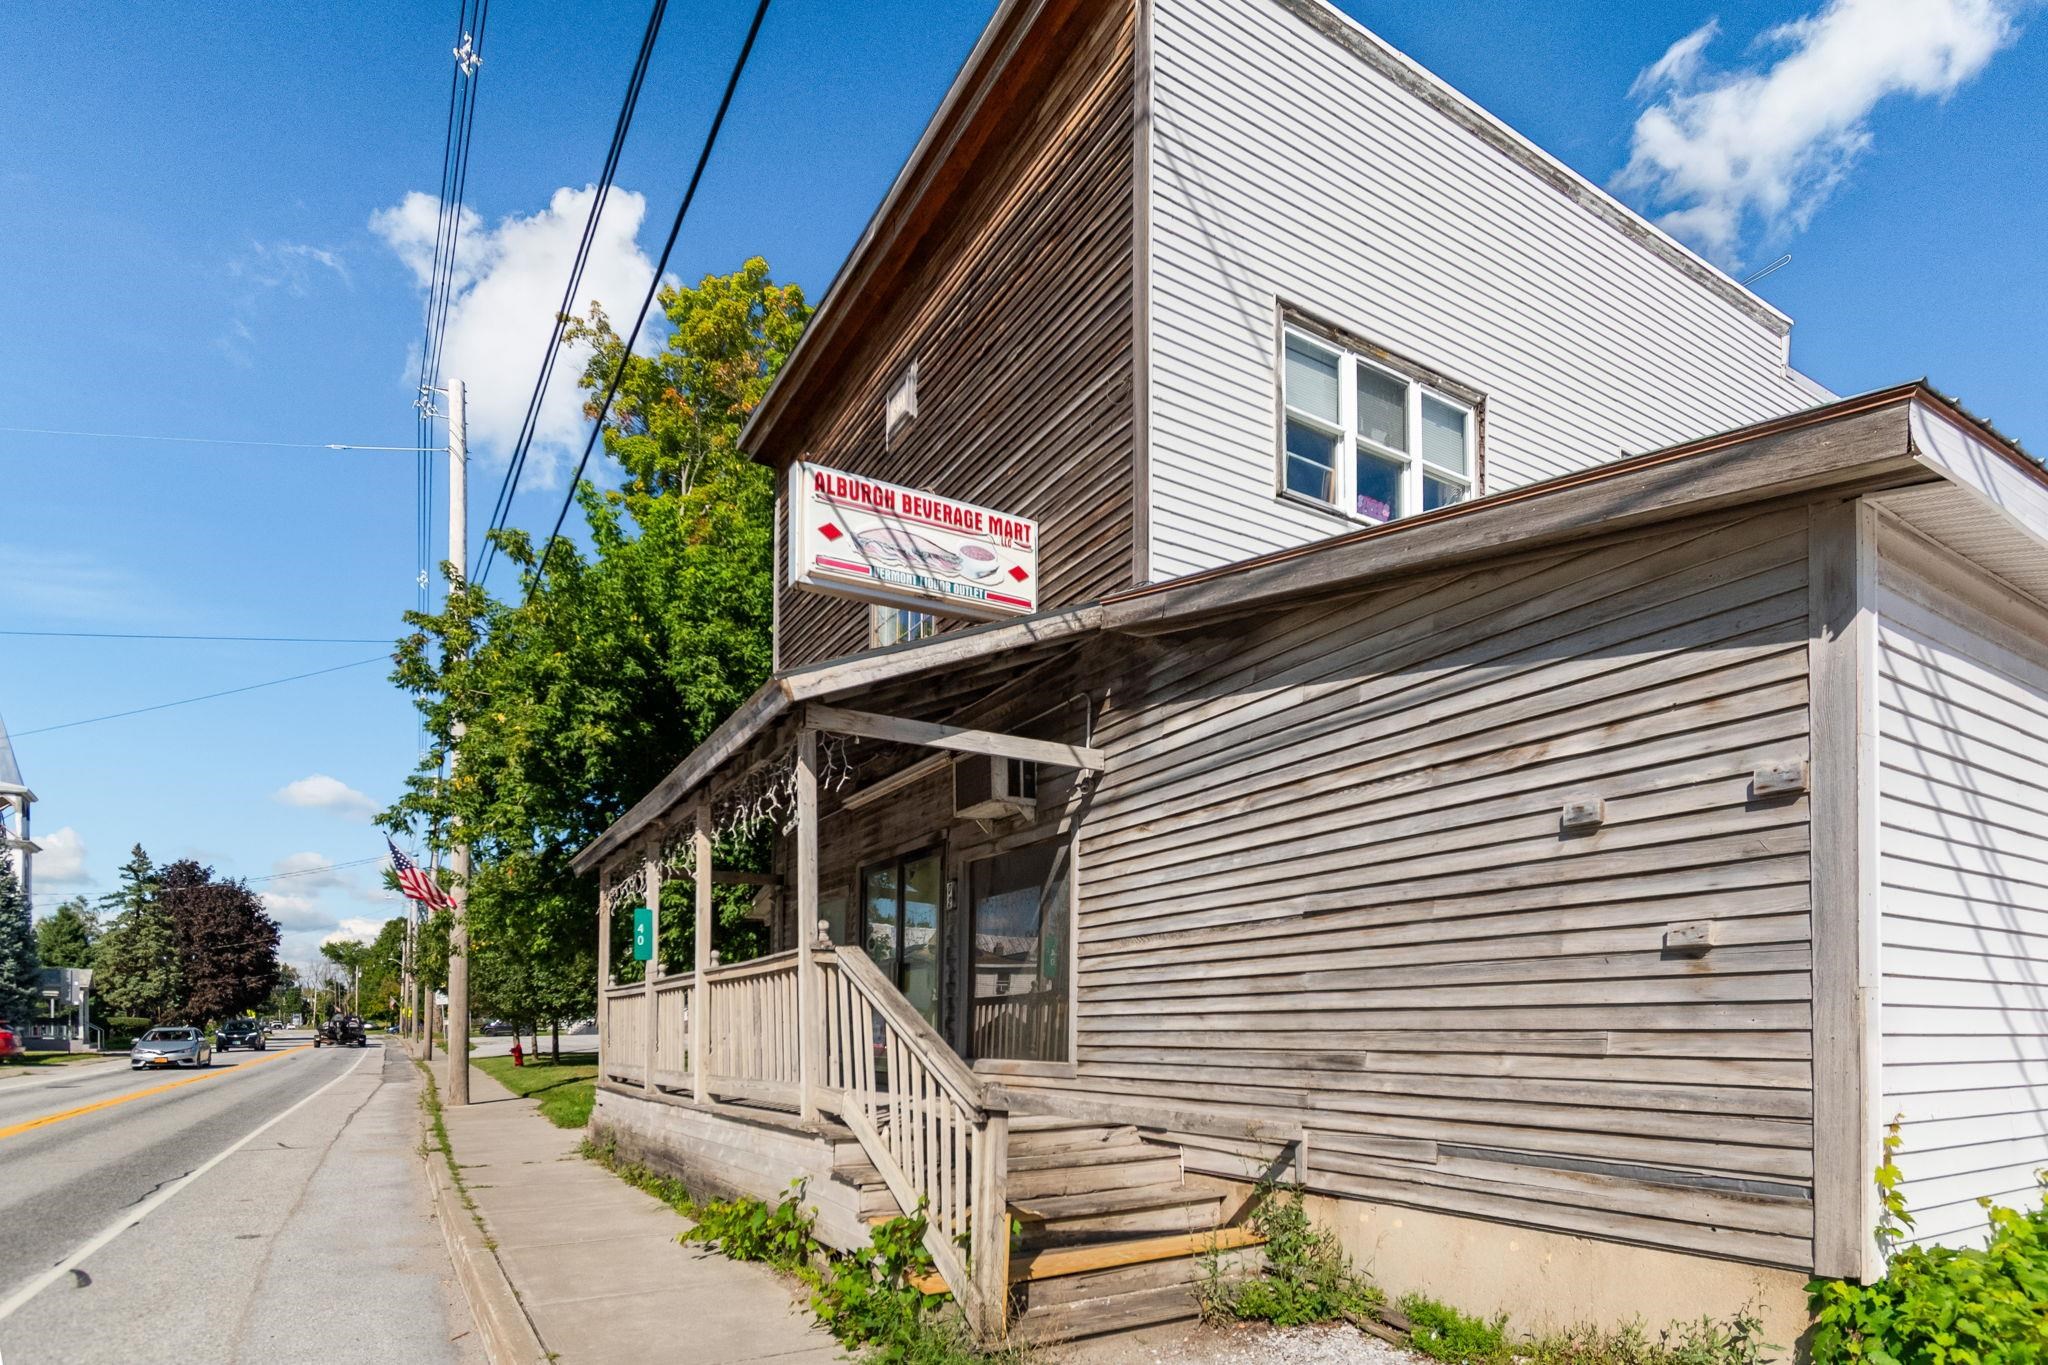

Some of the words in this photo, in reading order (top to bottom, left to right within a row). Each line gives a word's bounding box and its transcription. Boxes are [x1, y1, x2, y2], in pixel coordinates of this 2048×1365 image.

[814, 471, 895, 510] ALBURGH
[902, 494, 983, 532] BEVERAGE
[988, 515, 1031, 543] MART
[1001, 537, 1012, 549] LLC
[953, 582, 984, 599] OUTLET
[637, 923, 644, 946] 40
